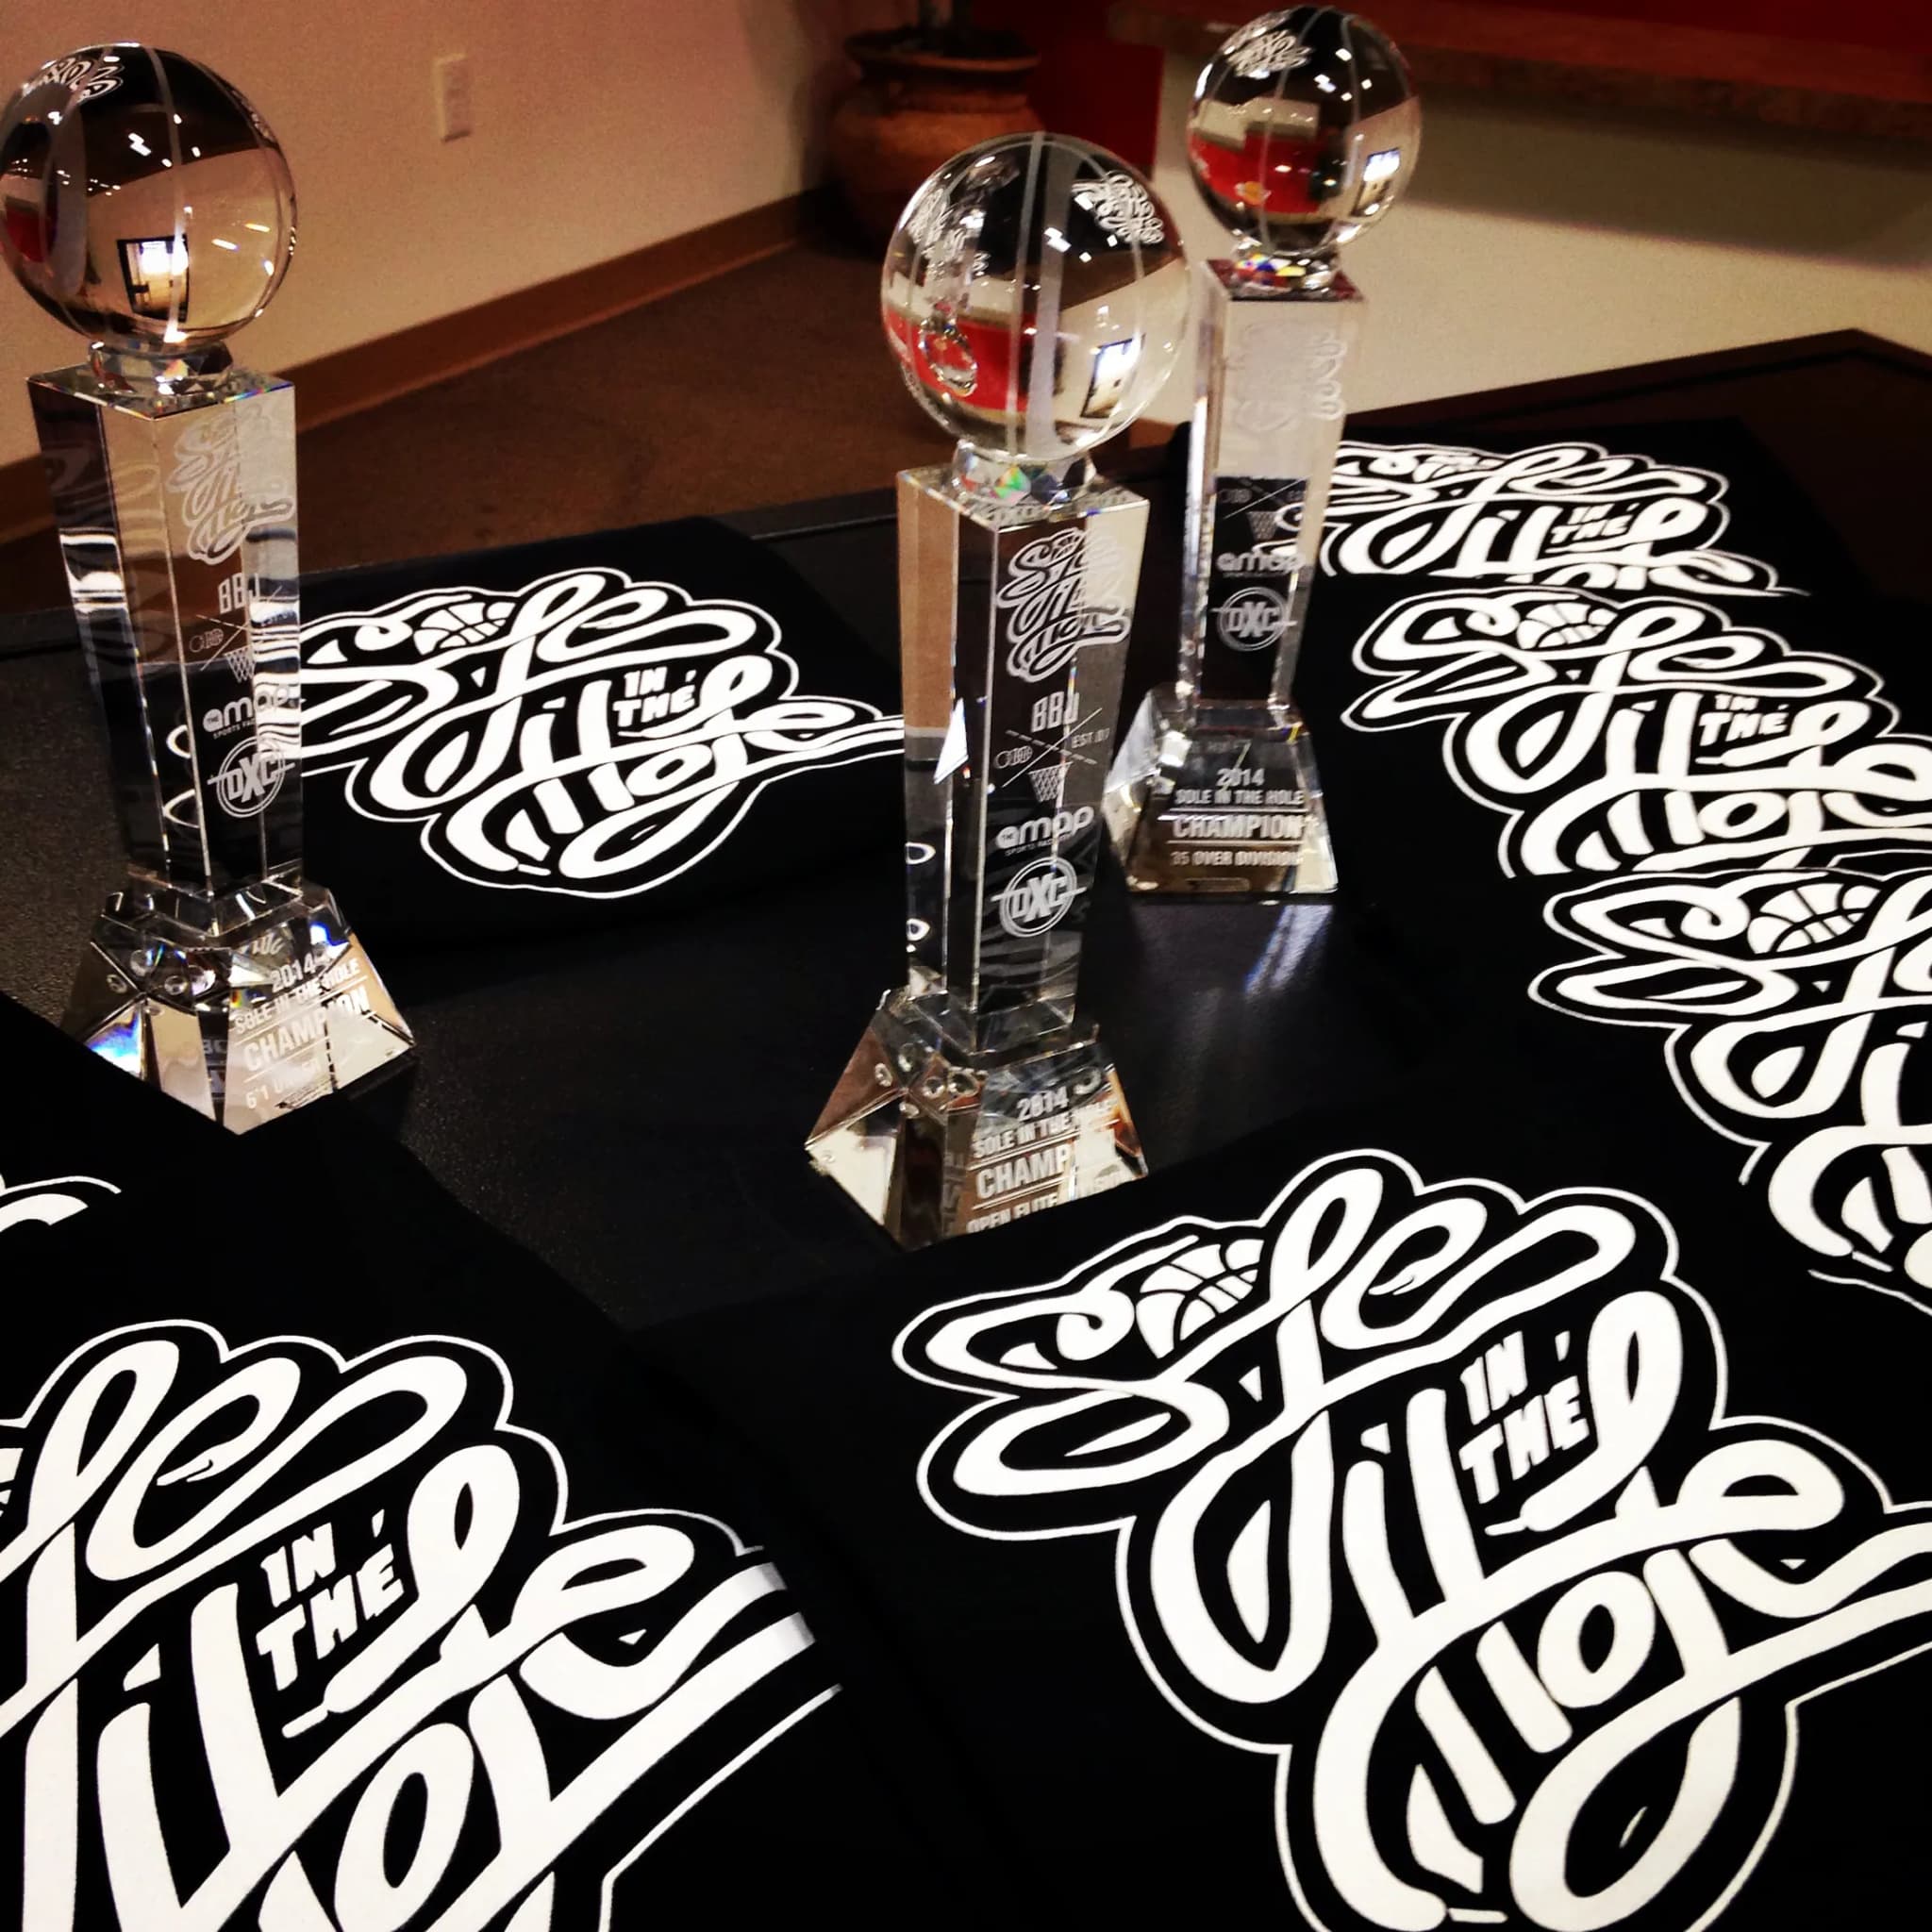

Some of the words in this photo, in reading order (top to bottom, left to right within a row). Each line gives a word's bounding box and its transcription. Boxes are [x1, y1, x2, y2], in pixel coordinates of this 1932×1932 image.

[1550, 521, 1634, 545] THE
[1226, 601, 1281, 639] DXC
[624, 667, 666, 693] IN
[613, 689, 696, 732] THE
[1031, 691, 1079, 732] BBU
[1698, 708, 1790, 747] THE
[225, 752, 277, 803] DXC
[1216, 768, 1266, 788] 2014
[1234, 790, 1264, 805] THE
[1173, 813, 1307, 839] CHAMPION
[1009, 872, 1068, 924] DXC
[270, 952, 317, 994] 2014
[1461, 1331, 1528, 1424] IN
[1460, 1375, 1591, 1504] THE
[260, 1523, 338, 1607] IN
[256, 1547, 405, 1691] THE
